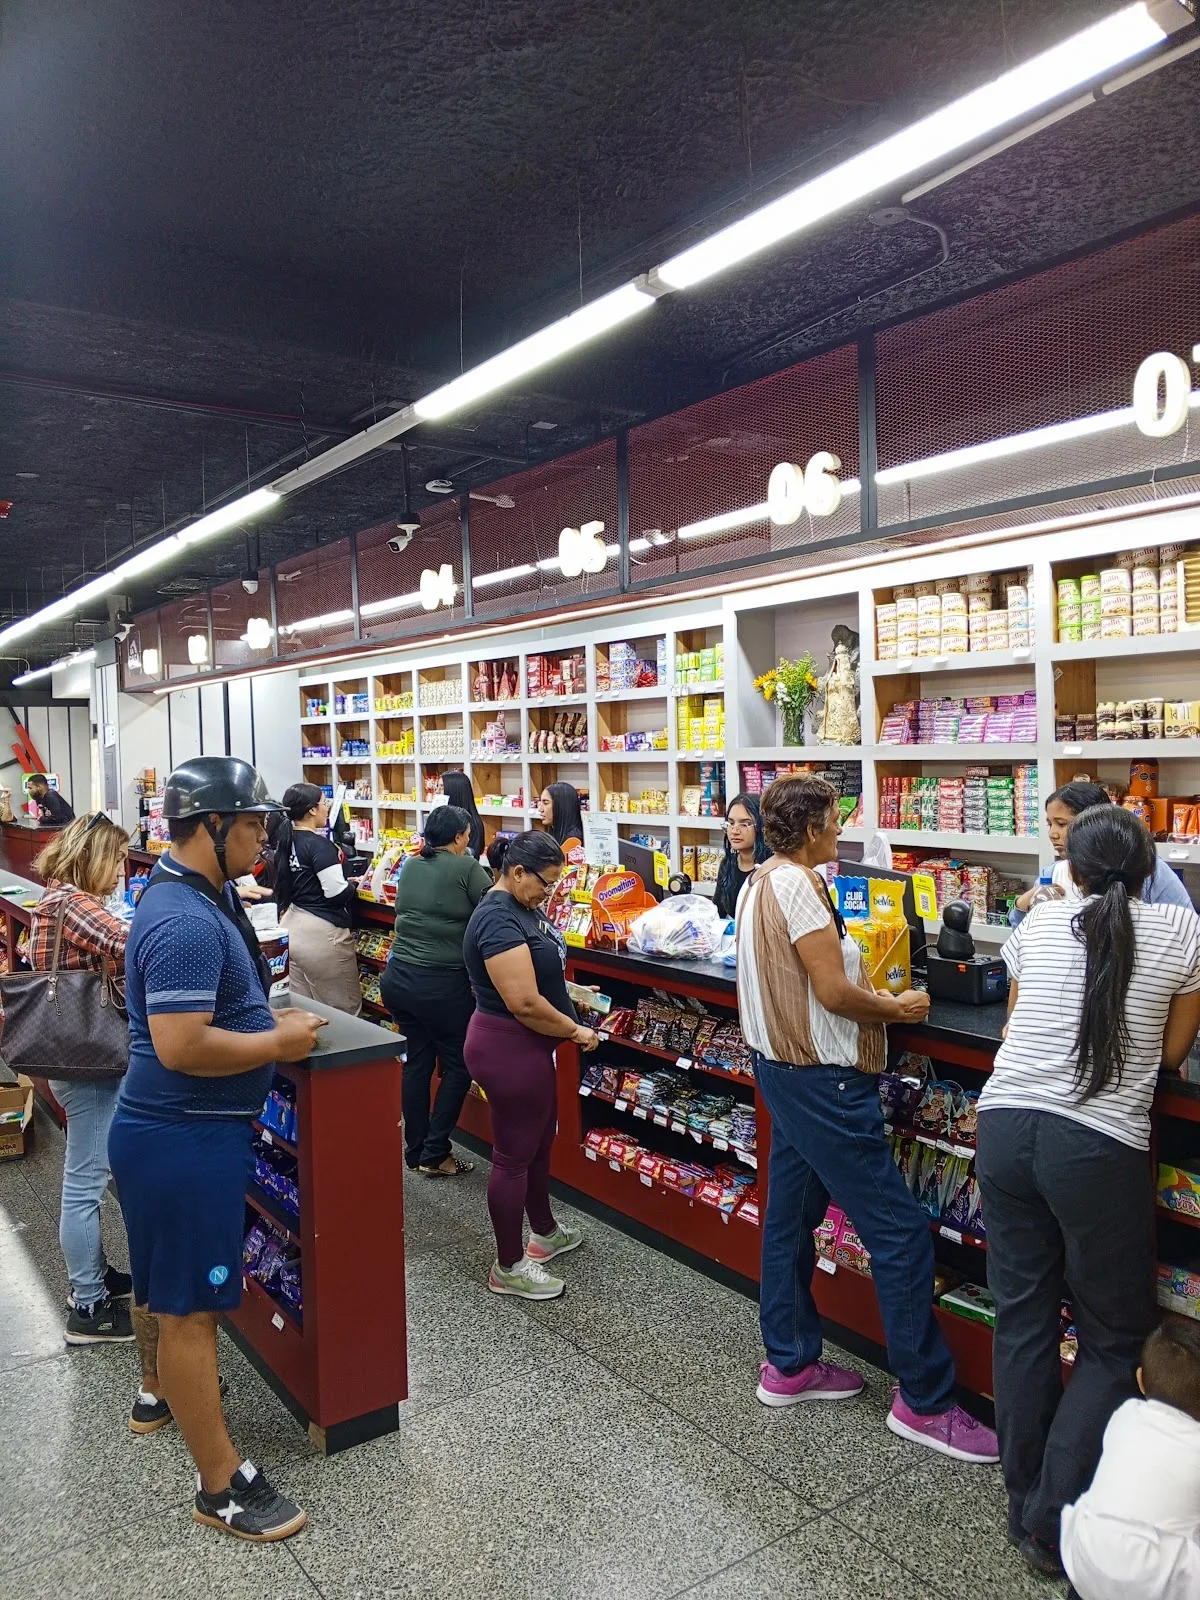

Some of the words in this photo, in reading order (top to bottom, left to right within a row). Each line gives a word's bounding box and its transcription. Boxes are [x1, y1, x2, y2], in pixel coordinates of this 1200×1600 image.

[1134, 344, 1200, 437] 0
[768, 451, 841, 525] 06
[559, 520, 607, 577] 05
[845, 891, 863, 901] CLUB
[873, 894, 896, 907] belVita
[885, 964, 906, 981] belVita
